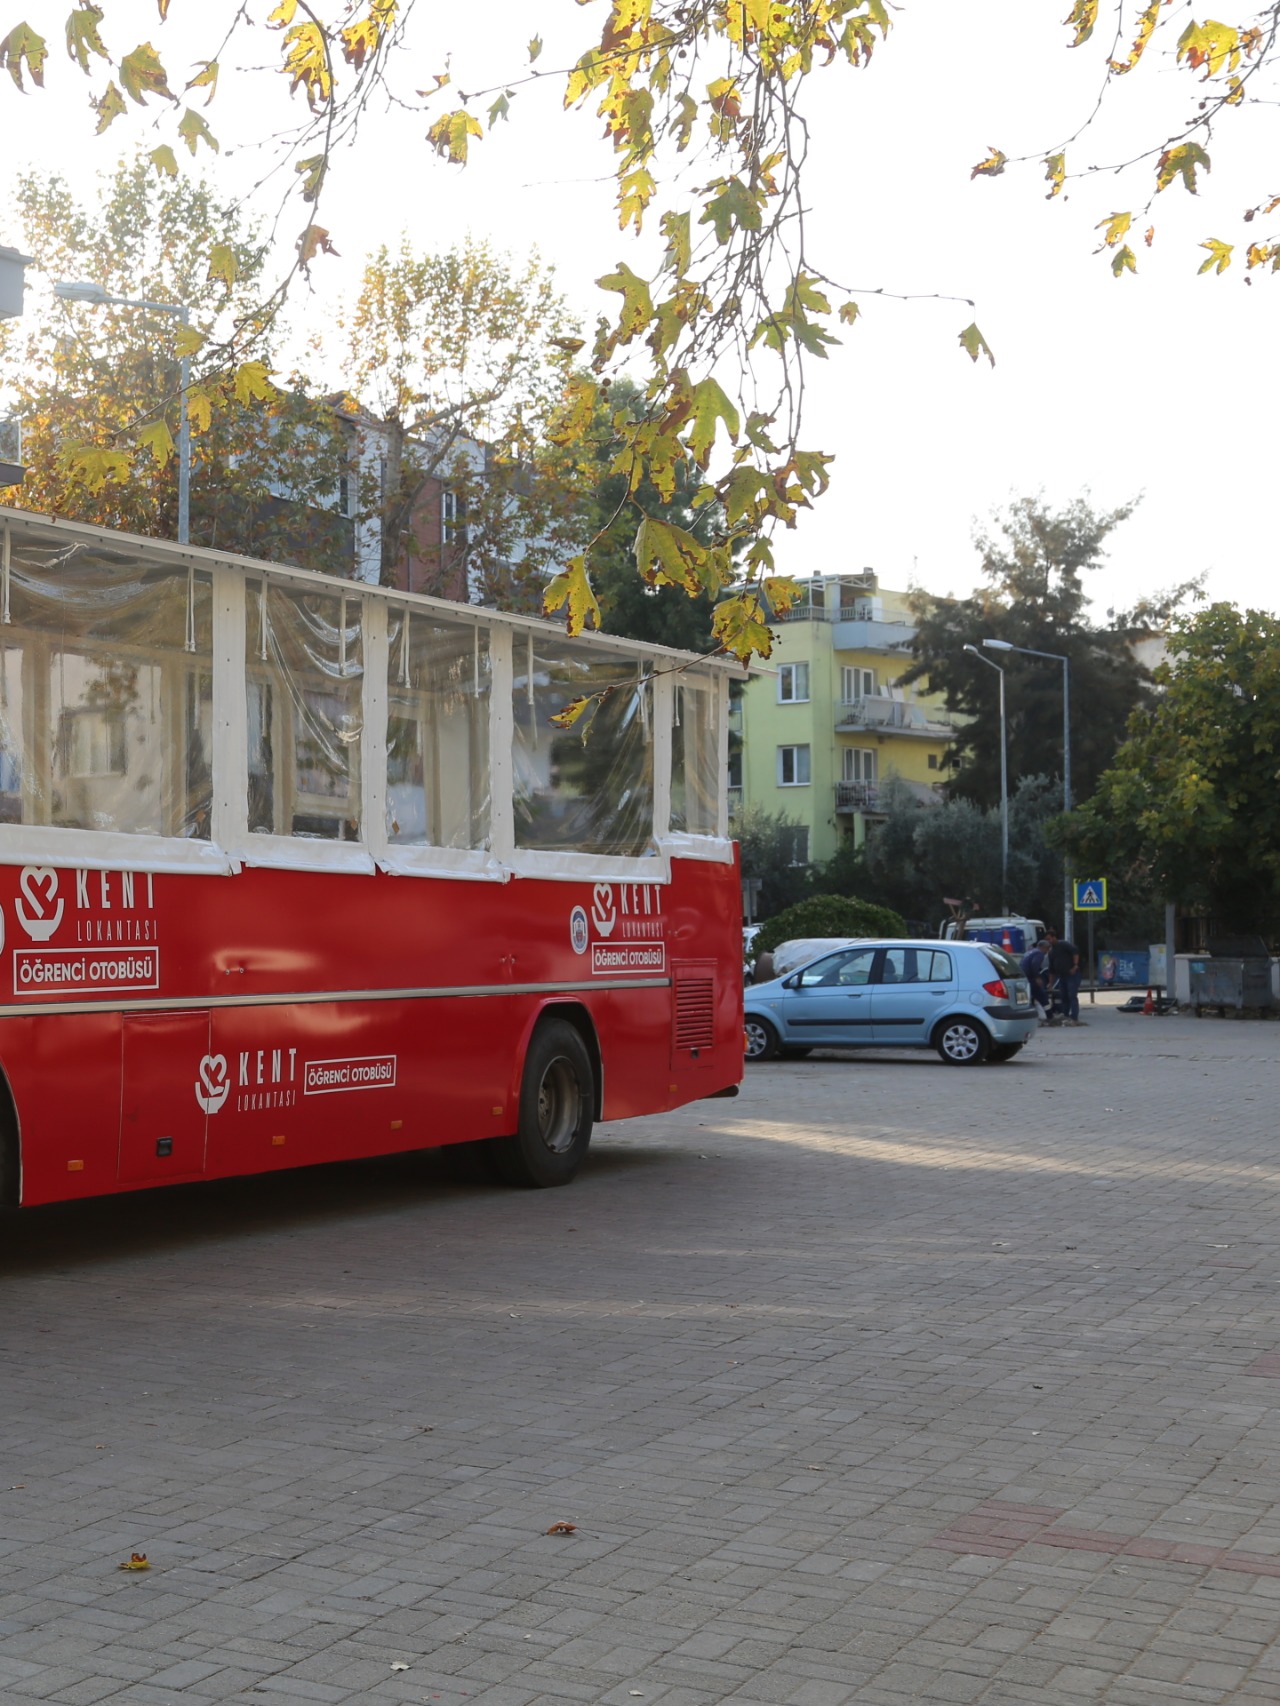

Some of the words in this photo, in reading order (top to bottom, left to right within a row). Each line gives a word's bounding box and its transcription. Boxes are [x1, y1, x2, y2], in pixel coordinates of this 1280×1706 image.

[76, 869, 155, 909] KENT
[620, 884, 661, 915] KENT
[77, 919, 157, 942] LOKANTASI
[20, 957, 86, 983] ÖĞRENCİ
[89, 956, 152, 980] OTOBÜSÜ
[595, 948, 629, 966] ÖĞRENCİ
[629, 948, 662, 965] OTOBÜSÜ
[239, 1048, 297, 1086] KENT
[308, 1065, 350, 1086] ÖĞRENCİ
[352, 1062, 392, 1082] OTOBÜSÜ
[237, 1089, 296, 1112] LOKANTASI
